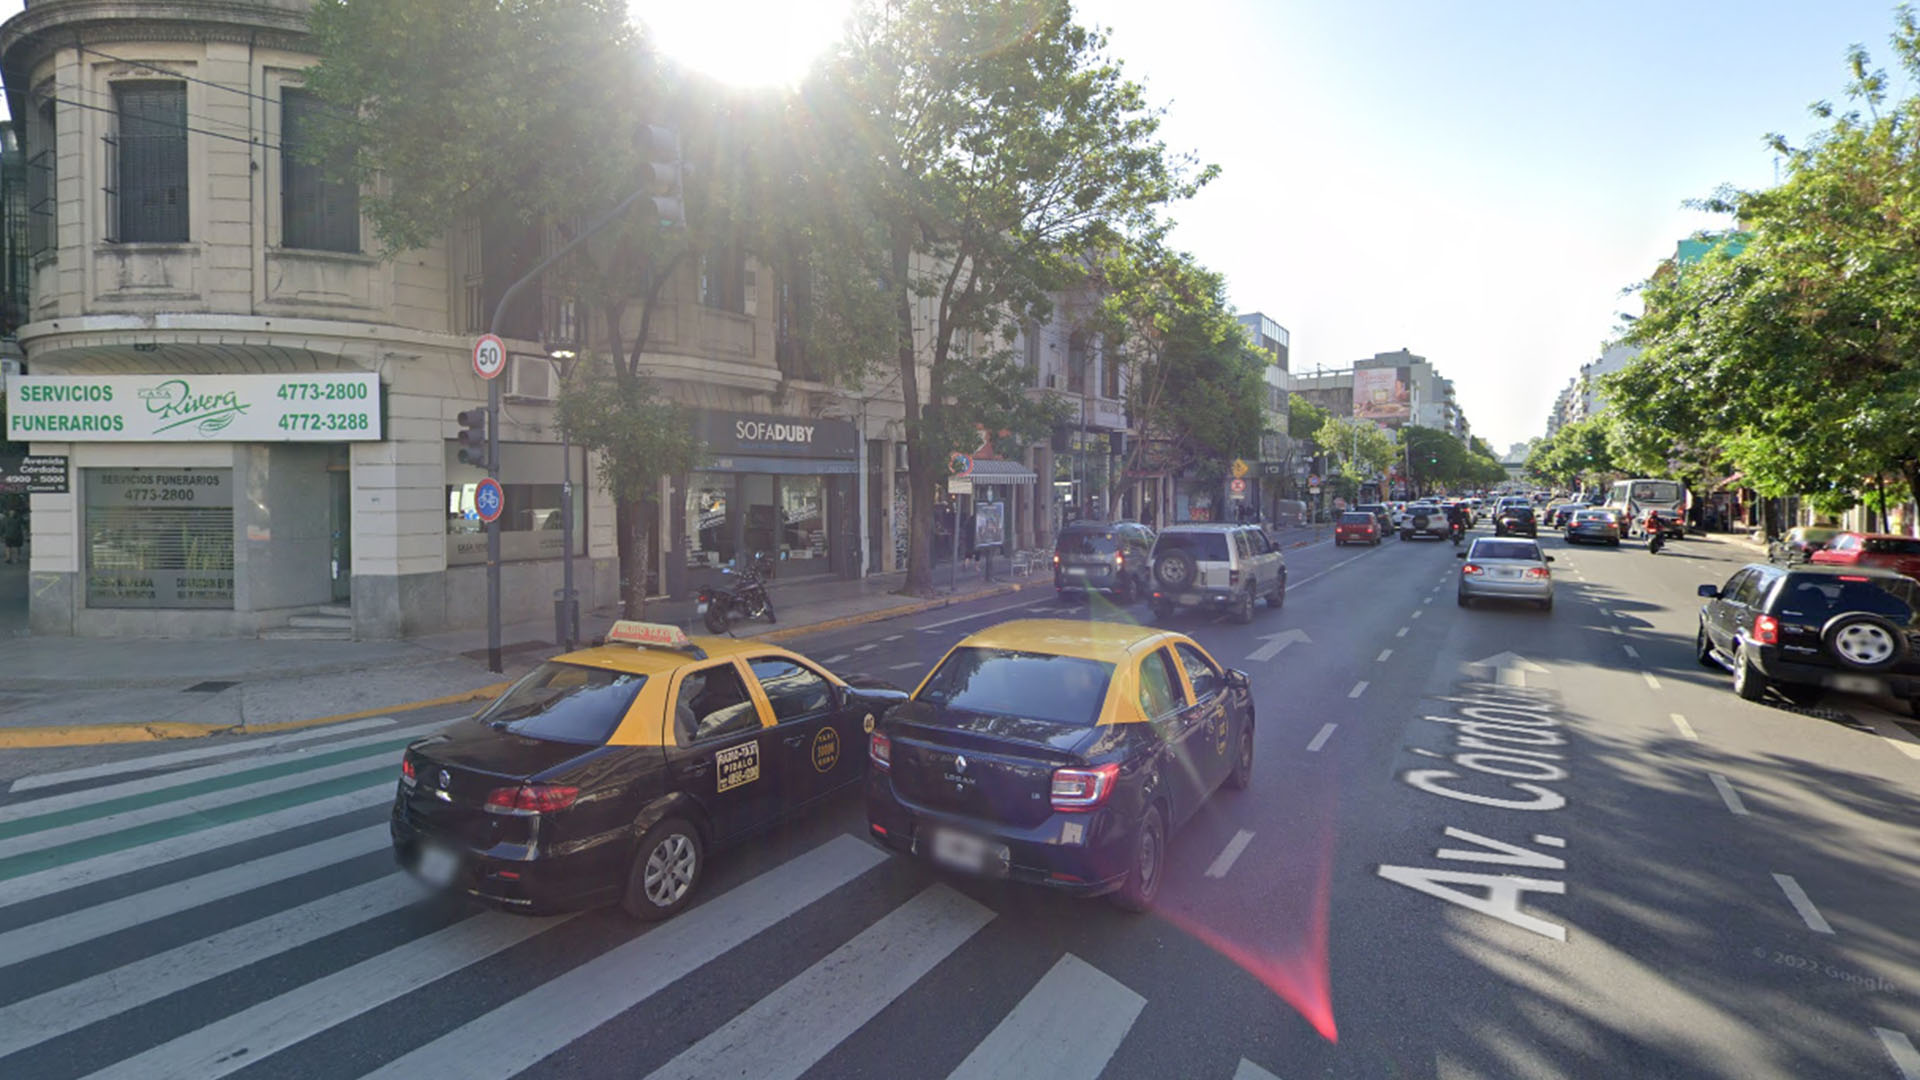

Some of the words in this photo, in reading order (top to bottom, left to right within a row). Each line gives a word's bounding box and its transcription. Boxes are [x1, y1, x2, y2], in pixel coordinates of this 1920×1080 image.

[479, 347, 498, 366] 50
[20, 384, 113, 402] SERVICIOS
[147, 379, 248, 420] Rivera
[277, 383, 367, 400] 4773-2800
[12, 414, 124, 432] FUNERARIOS
[278, 413, 369, 430] 4772-3288
[735, 420, 815, 443] SOFADUBY
[22, 456, 65, 465] Avenida
[20, 465, 65, 474] Córdoba
[101, 474, 154, 486] SERVICIOS
[156, 474, 220, 486] FUNERARIOS
[124, 488, 195, 501] 4773-2800
